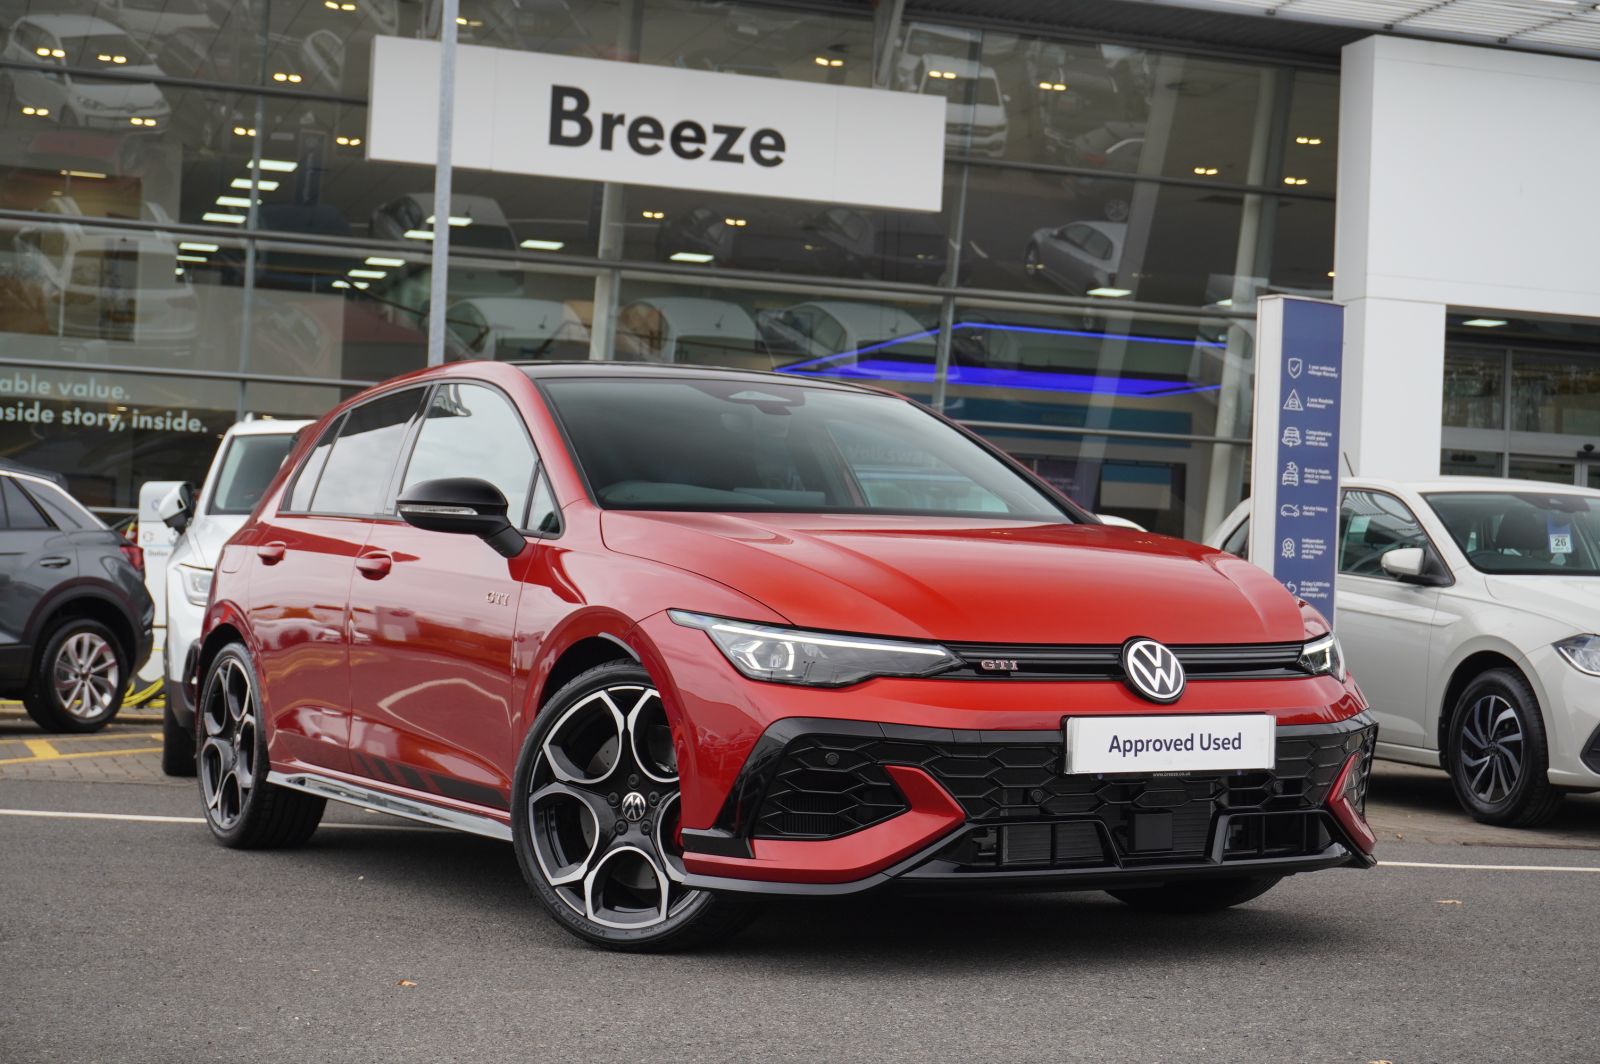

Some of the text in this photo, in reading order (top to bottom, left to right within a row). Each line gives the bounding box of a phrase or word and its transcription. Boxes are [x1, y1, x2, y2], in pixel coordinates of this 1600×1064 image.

[548, 84, 787, 168] Breeze
[58, 377, 131, 400] value.
[61, 408, 125, 431] story,
[131, 409, 208, 433] inside.
[1554, 538, 1567, 547] 26
[980, 659, 1019, 671] GTI
[1107, 732, 1242, 758] Approved Used
